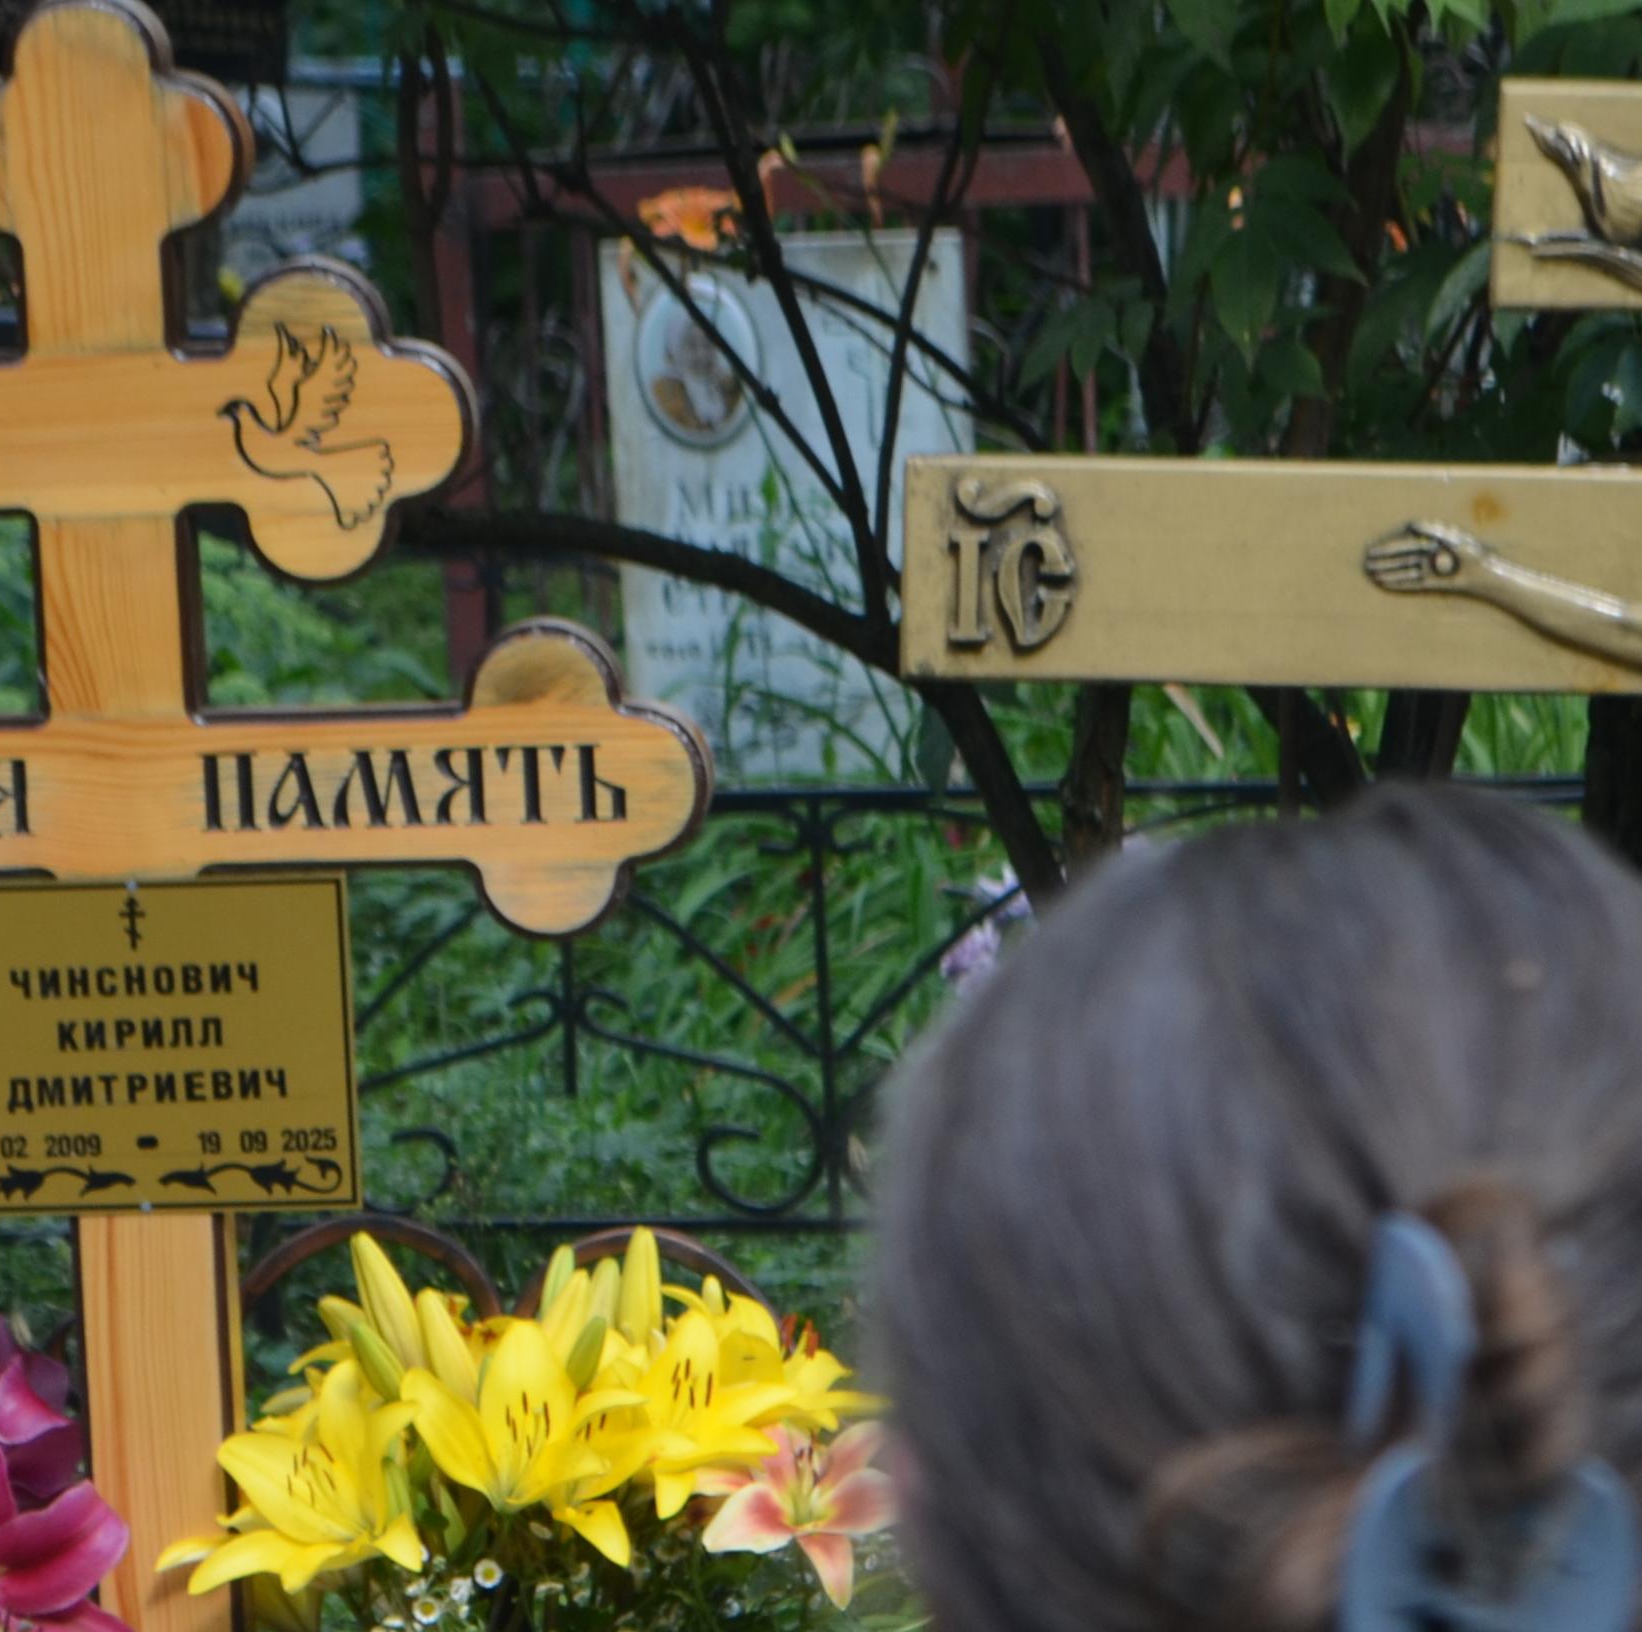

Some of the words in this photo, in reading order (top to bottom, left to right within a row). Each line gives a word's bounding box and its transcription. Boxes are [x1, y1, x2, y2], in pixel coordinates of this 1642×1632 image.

[199, 744, 627, 832] ПАМЯТЬ
[9, 962, 260, 999] ЧИНСНОВИЧ
[56, 1016, 224, 1051] КИРИЛЛ
[7, 1068, 288, 1114] ДМИТРИЕВИЧ
[0, 1135, 28, 1158] 02
[45, 1134, 102, 1157] 2009
[197, 1131, 222, 1155] 19
[240, 1130, 268, 1153] 09
[281, 1128, 338, 1152] 2025
